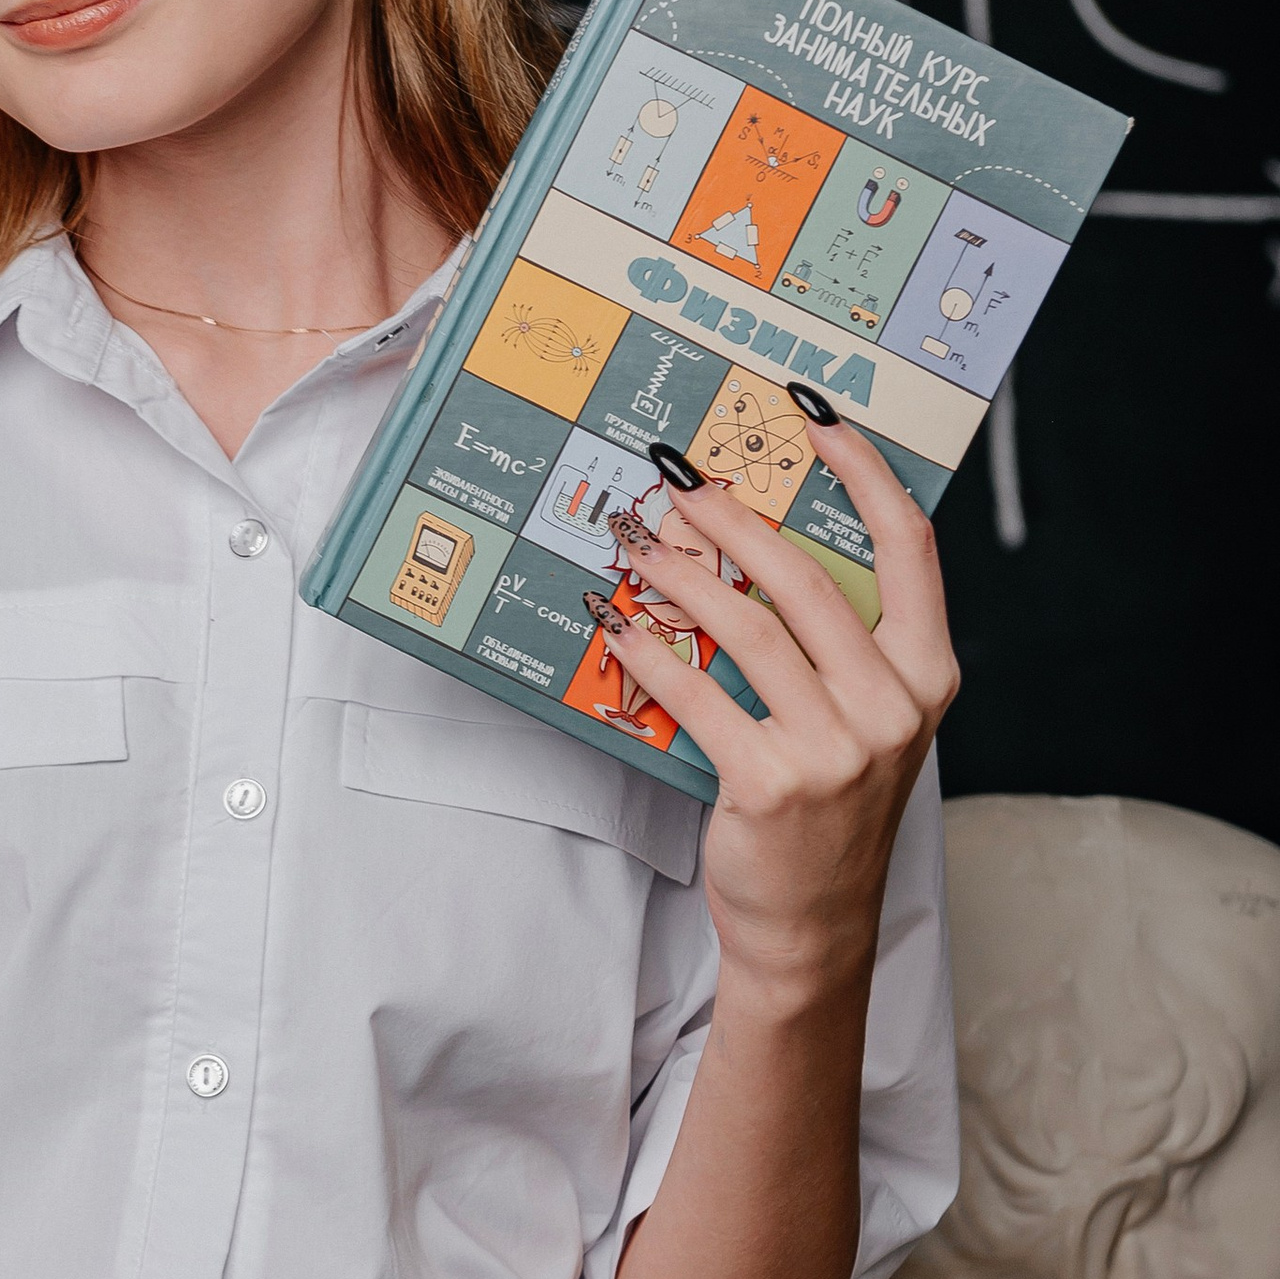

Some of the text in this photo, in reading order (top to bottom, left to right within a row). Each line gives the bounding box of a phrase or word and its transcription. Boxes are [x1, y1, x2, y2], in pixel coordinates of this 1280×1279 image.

[763, 13, 997, 147] ЗАНИМАТЕЛЬНЫХ
[918, 50, 990, 106] КУРС
[823, 80, 904, 140] НАУК
[604, 412, 660, 444] ПРУЖИННЫЙ
[605, 426, 651, 454] МАЯТНИК
[427, 477, 511, 524] МАССЫ И ЭНЕРГИИ
[431, 465, 515, 514] ЭКВИВАЛЕНТНОСТЬ
[805, 522, 875, 562] СИЛЫ ТЯЖЕСТИ
[823, 518, 865, 544] ЭНЕРГИЯ
[476, 644, 552, 688] ГАЗОВЫЙ ЗАКОН
[482, 635, 555, 677] ОБЪЕДИНЕННЫЙ
